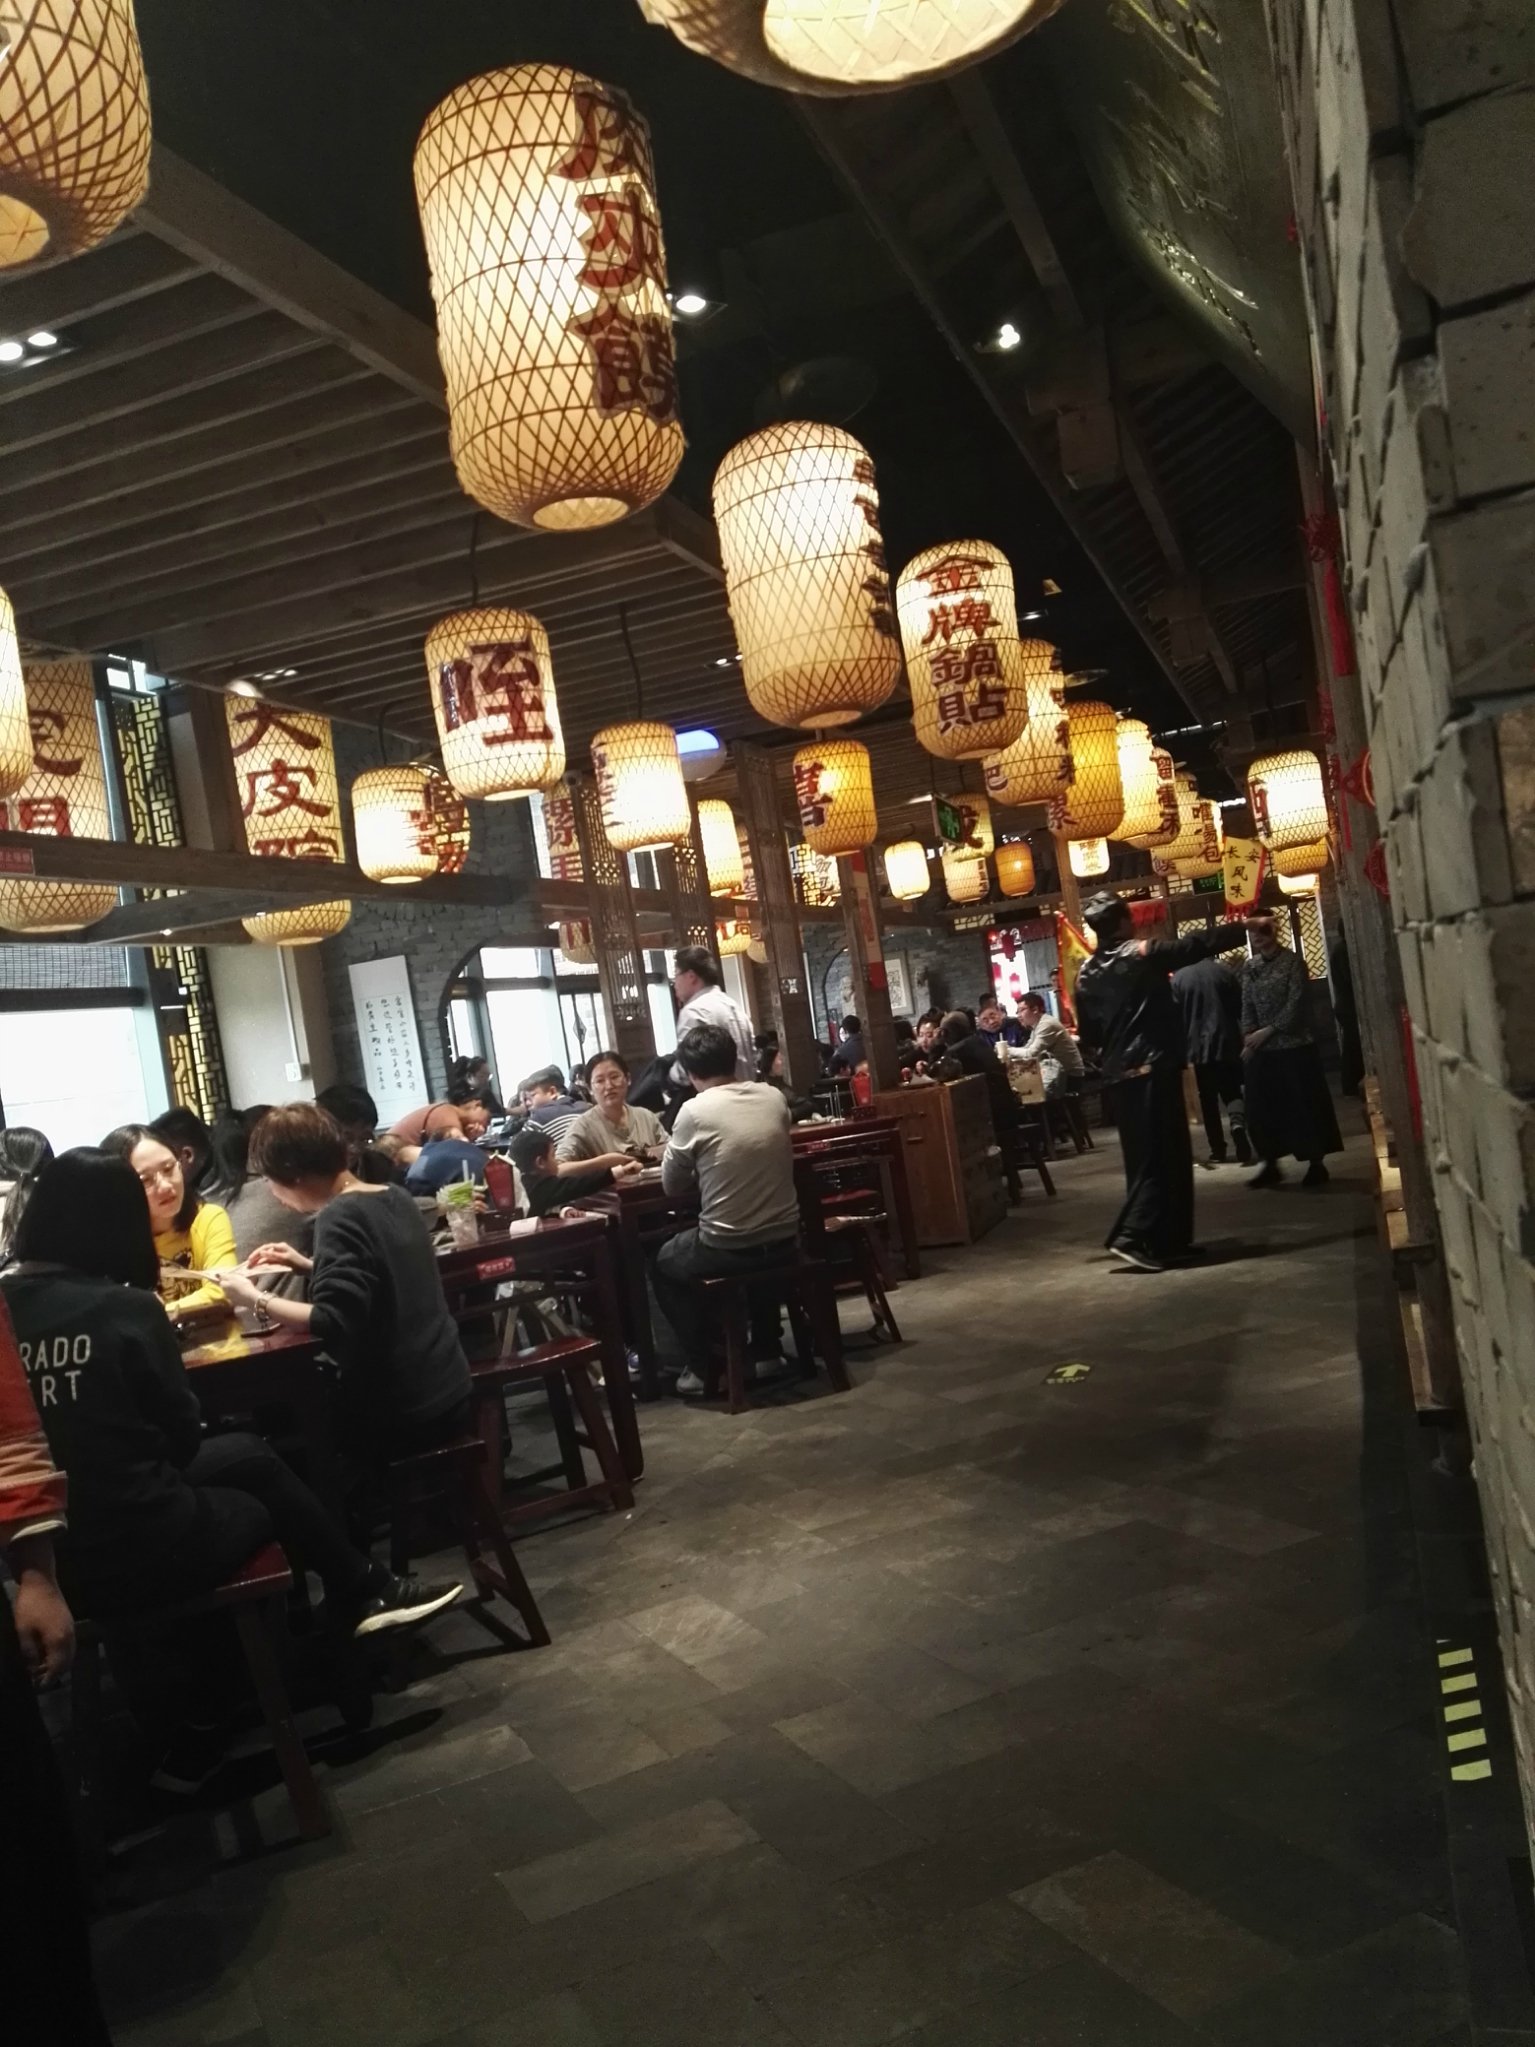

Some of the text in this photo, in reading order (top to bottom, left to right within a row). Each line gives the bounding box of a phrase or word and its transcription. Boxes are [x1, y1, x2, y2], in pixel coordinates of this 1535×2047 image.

[915, 554, 1007, 736] 金牌鍋貼
[19, 1333, 91, 1372] RADO
[27, 1369, 82, 1407] RT
